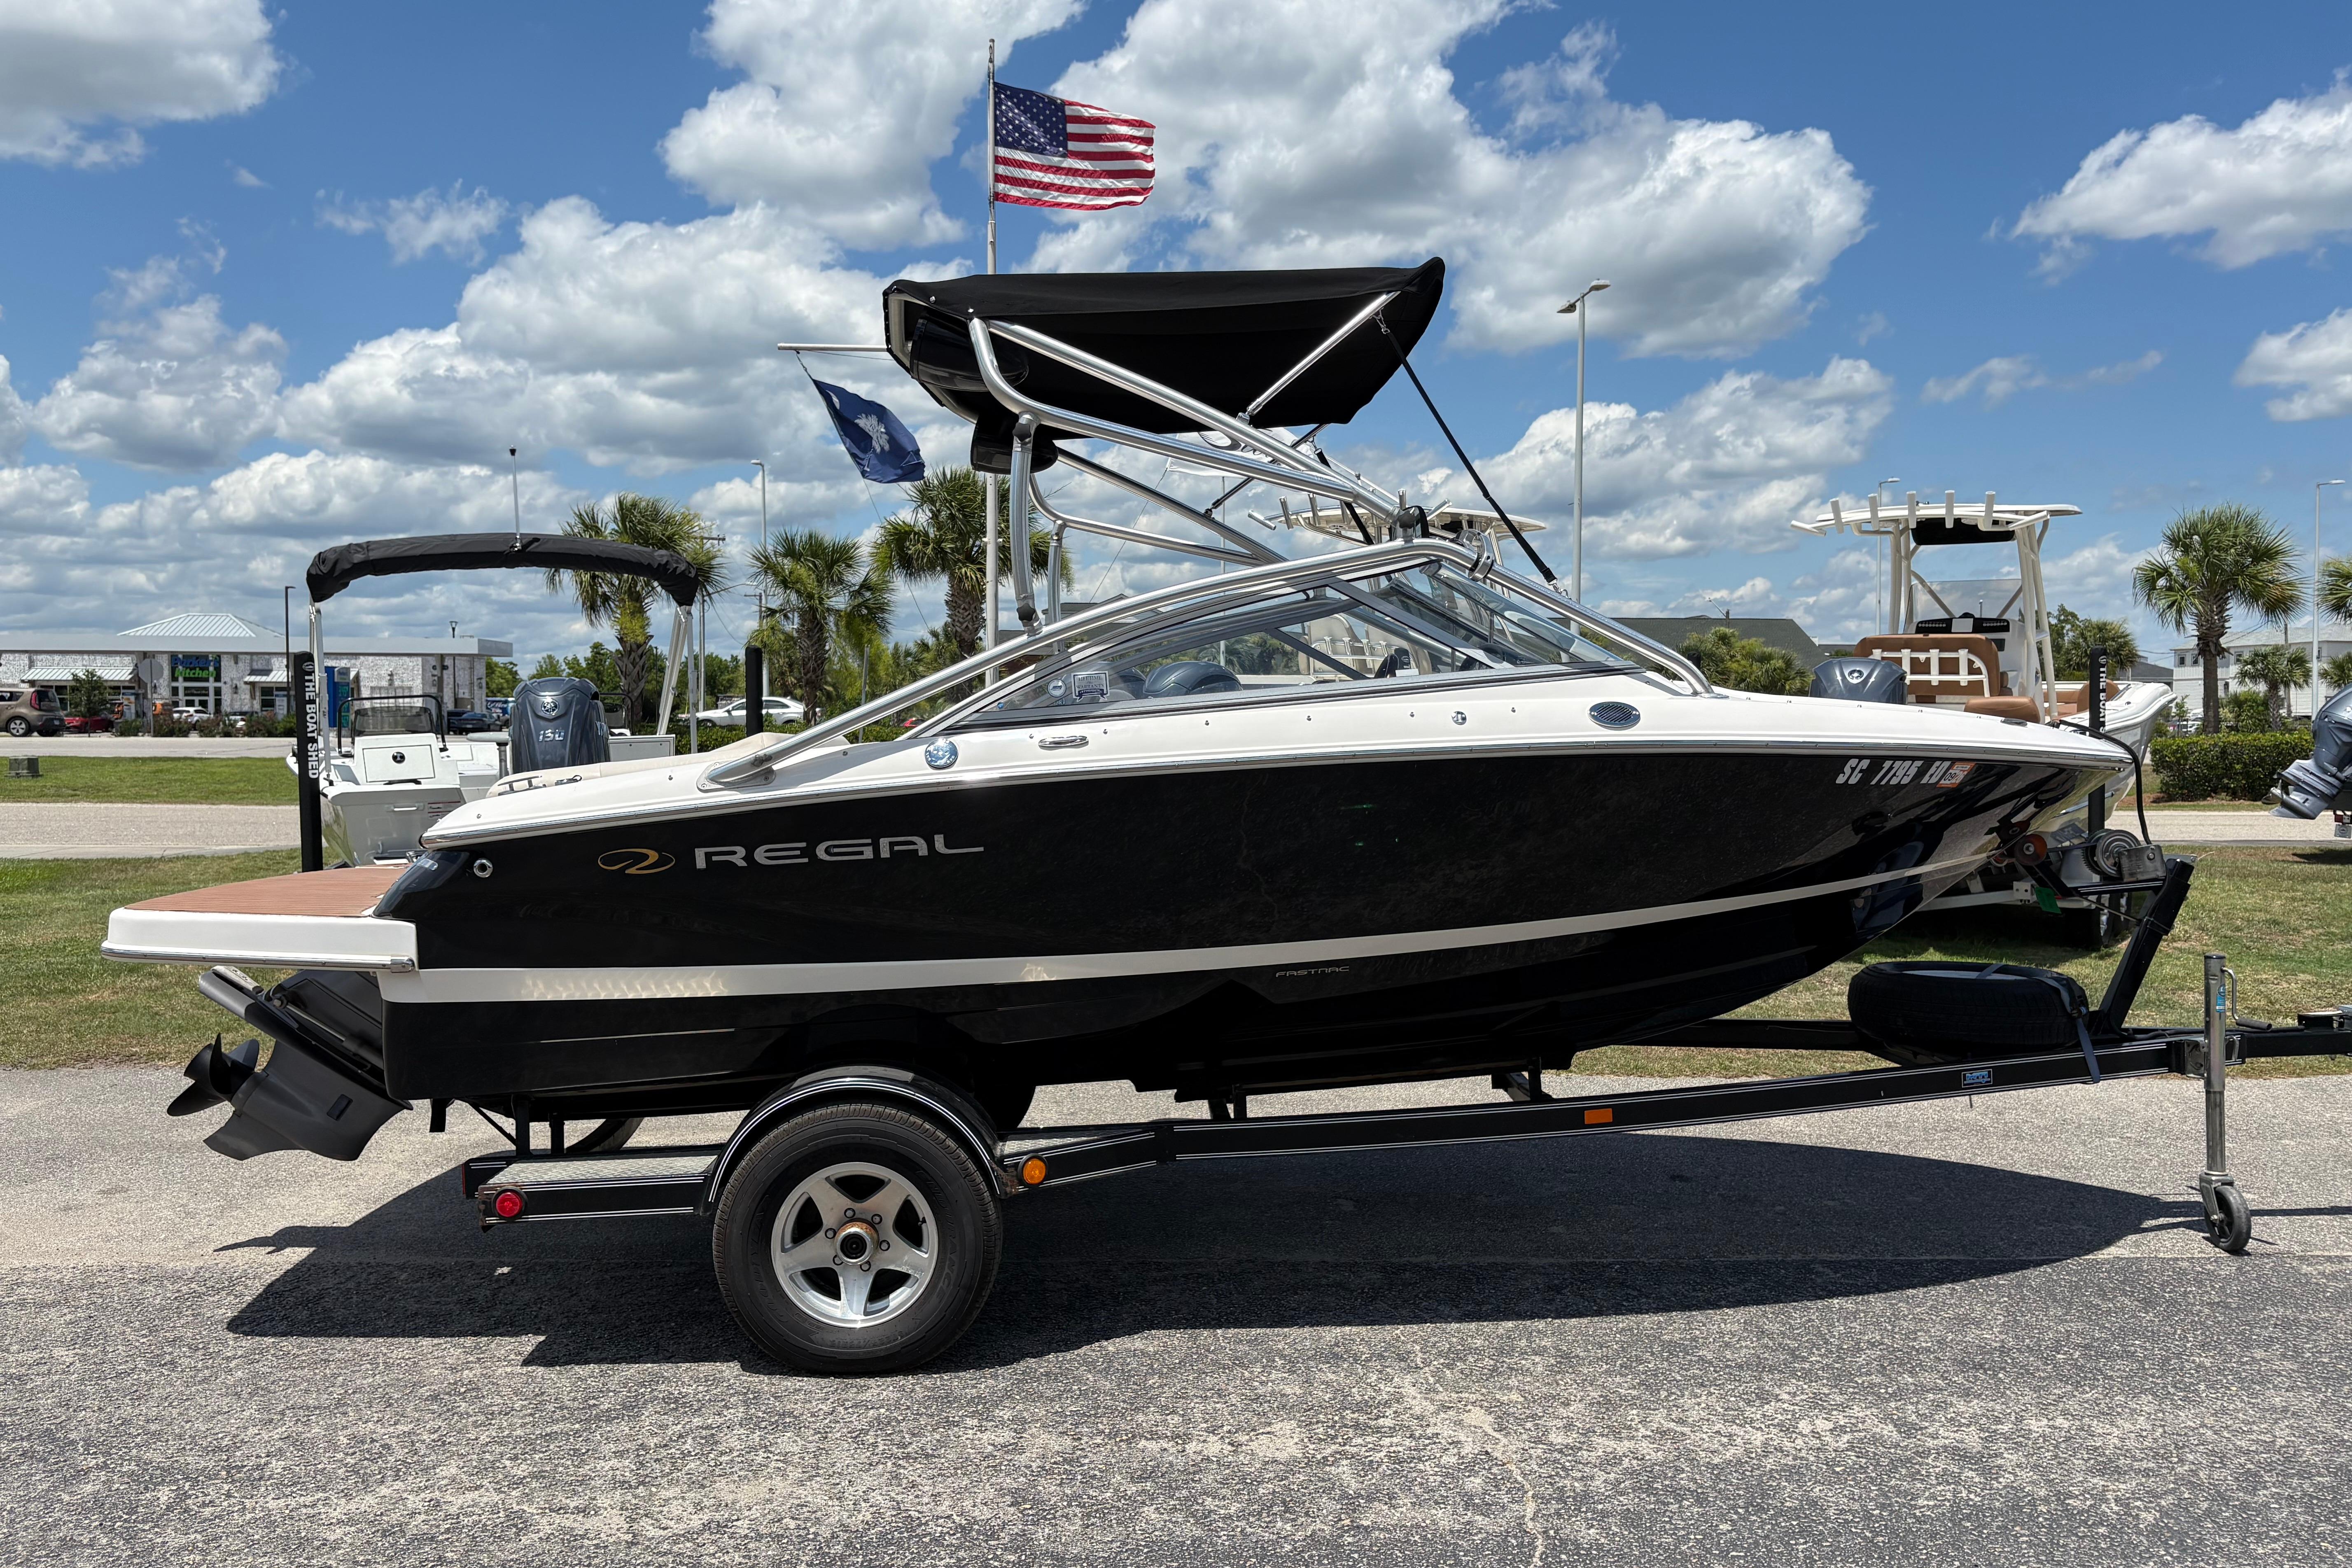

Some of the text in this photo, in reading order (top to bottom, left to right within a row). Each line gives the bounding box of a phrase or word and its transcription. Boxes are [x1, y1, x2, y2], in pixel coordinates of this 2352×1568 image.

[305, 673, 319, 779] THE BOAT SHED
[539, 729, 565, 741] 150
[1836, 758, 1952, 785] SC 7795 ED
[1944, 772, 1956, 781] 09
[695, 834, 984, 869] REGAL
[1276, 966, 1349, 978] FASTRAC
